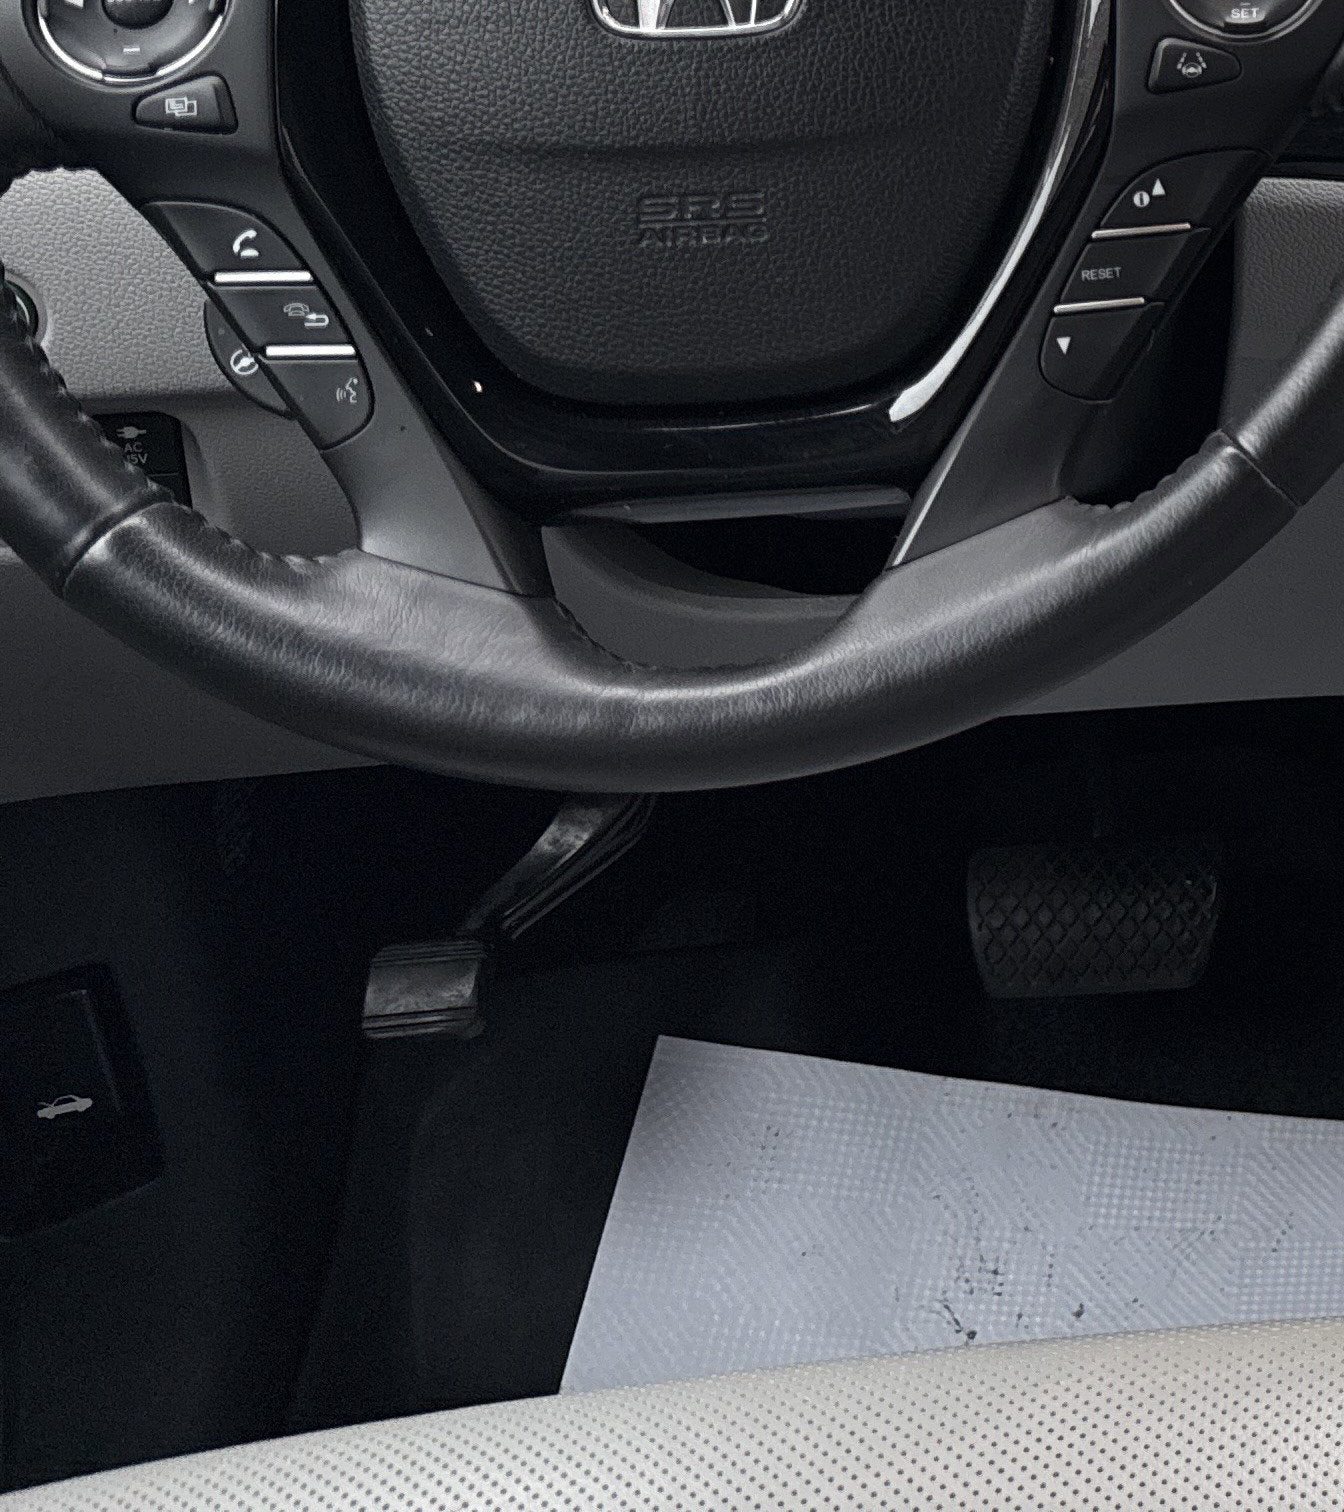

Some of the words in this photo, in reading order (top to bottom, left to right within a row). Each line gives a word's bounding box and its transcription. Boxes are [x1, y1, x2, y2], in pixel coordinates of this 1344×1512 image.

[1231, 7, 1260, 19] SET
[1081, 267, 1122, 282] RESET
[124, 442, 143, 453] AC
